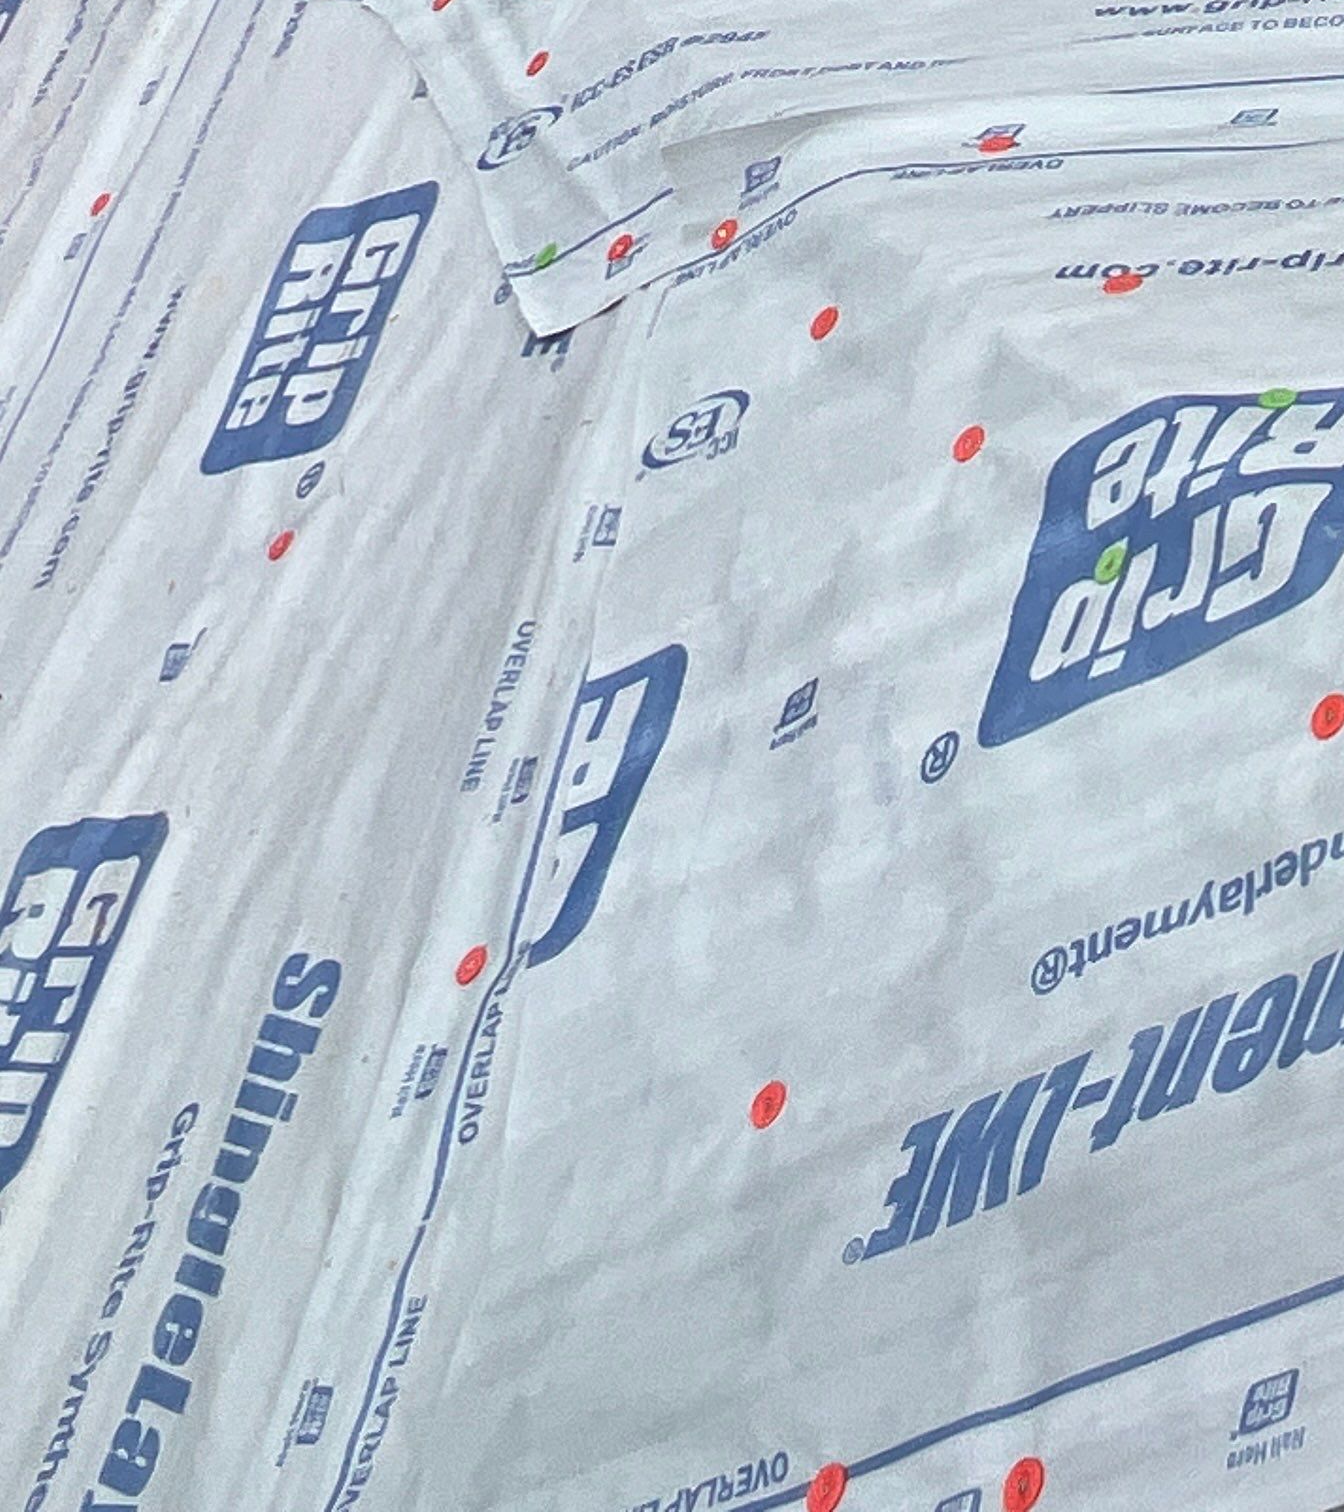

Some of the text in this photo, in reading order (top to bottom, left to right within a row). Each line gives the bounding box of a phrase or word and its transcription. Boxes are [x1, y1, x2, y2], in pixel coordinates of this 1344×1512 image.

[1045, 200, 1171, 219] SLIPPERY
[1176, 199, 1283, 218] BECOME
[1286, 196, 1317, 209] TO
[225, 236, 356, 431] Rite
[283, 213, 422, 426] Grip
[1029, 481, 1336, 683] Grip
[461, 619, 537, 795] OVERLAP LINE
[334, 1293, 428, 1512] LINE VERLAP
